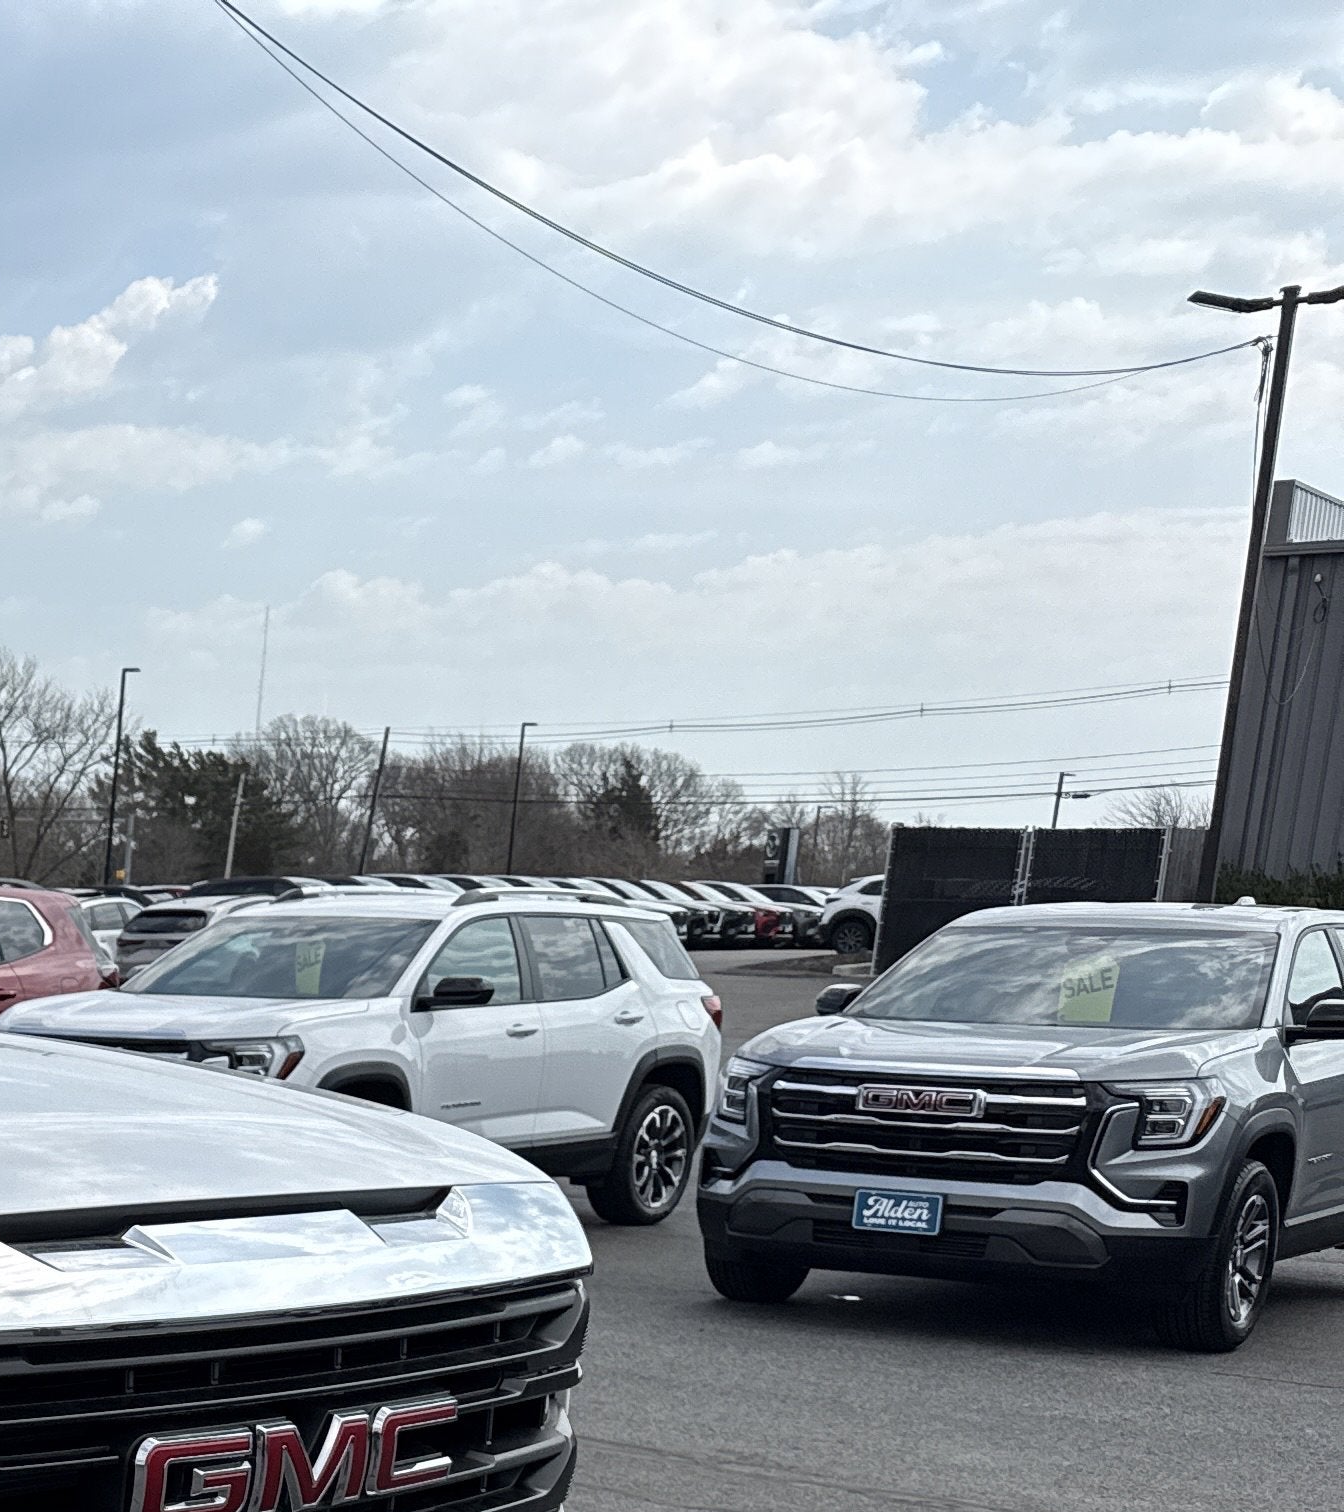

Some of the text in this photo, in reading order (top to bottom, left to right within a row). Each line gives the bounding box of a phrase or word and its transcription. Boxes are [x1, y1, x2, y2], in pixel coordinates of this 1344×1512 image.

[1063, 967, 1114, 998] SALE
[863, 1088, 974, 1113] GMC
[862, 1196, 931, 1220] Alden
[863, 1216, 887, 1225] LOVE
[898, 1220, 929, 1228] LOCAL
